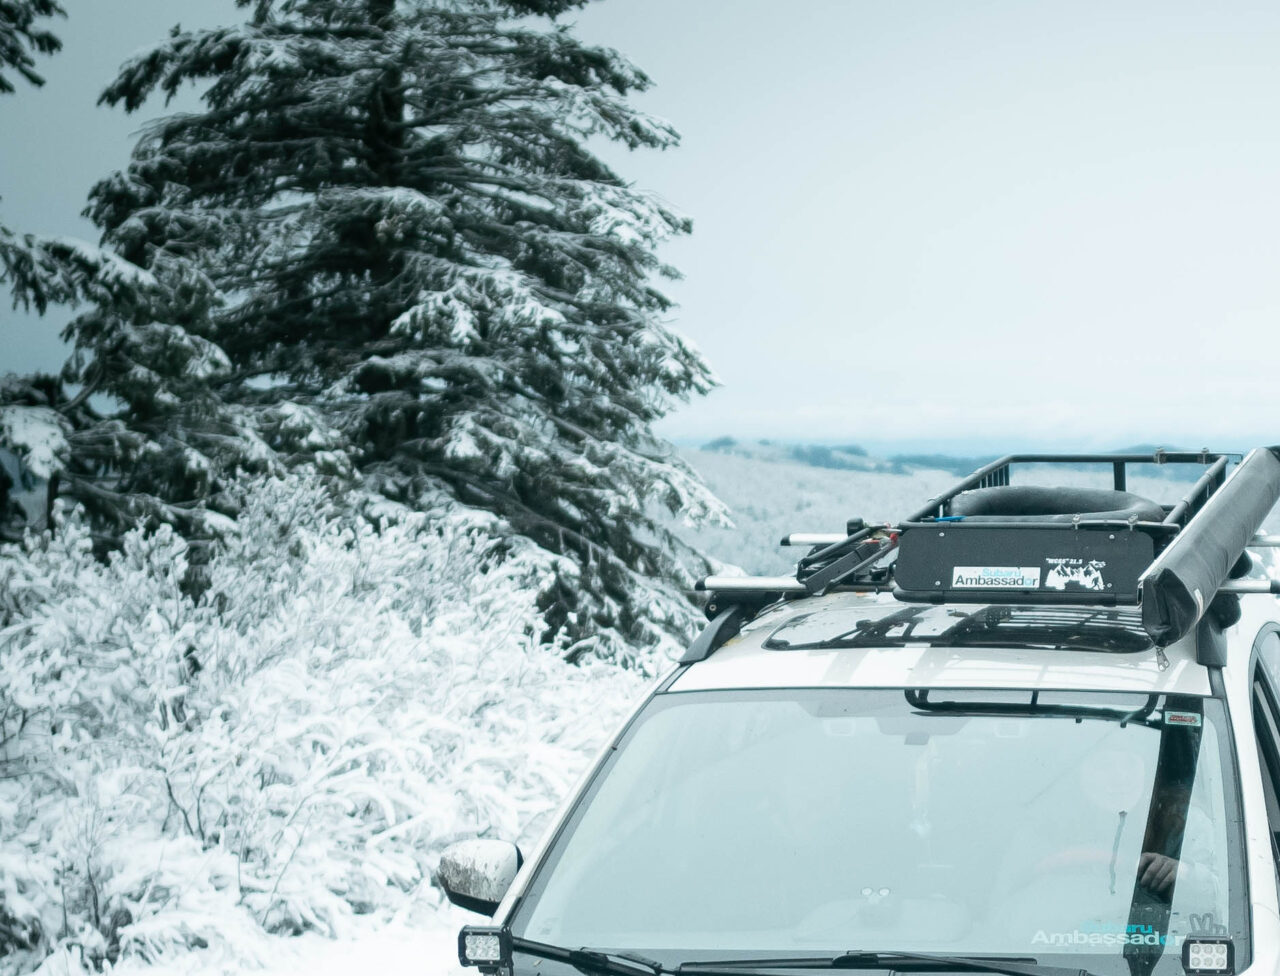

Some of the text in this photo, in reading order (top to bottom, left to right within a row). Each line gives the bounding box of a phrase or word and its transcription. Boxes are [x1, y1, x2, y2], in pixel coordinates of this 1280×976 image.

[982, 567, 1022, 577] Subaru
[955, 575, 1038, 586] Ambassador
[1030, 929, 1187, 946] Ambassador
